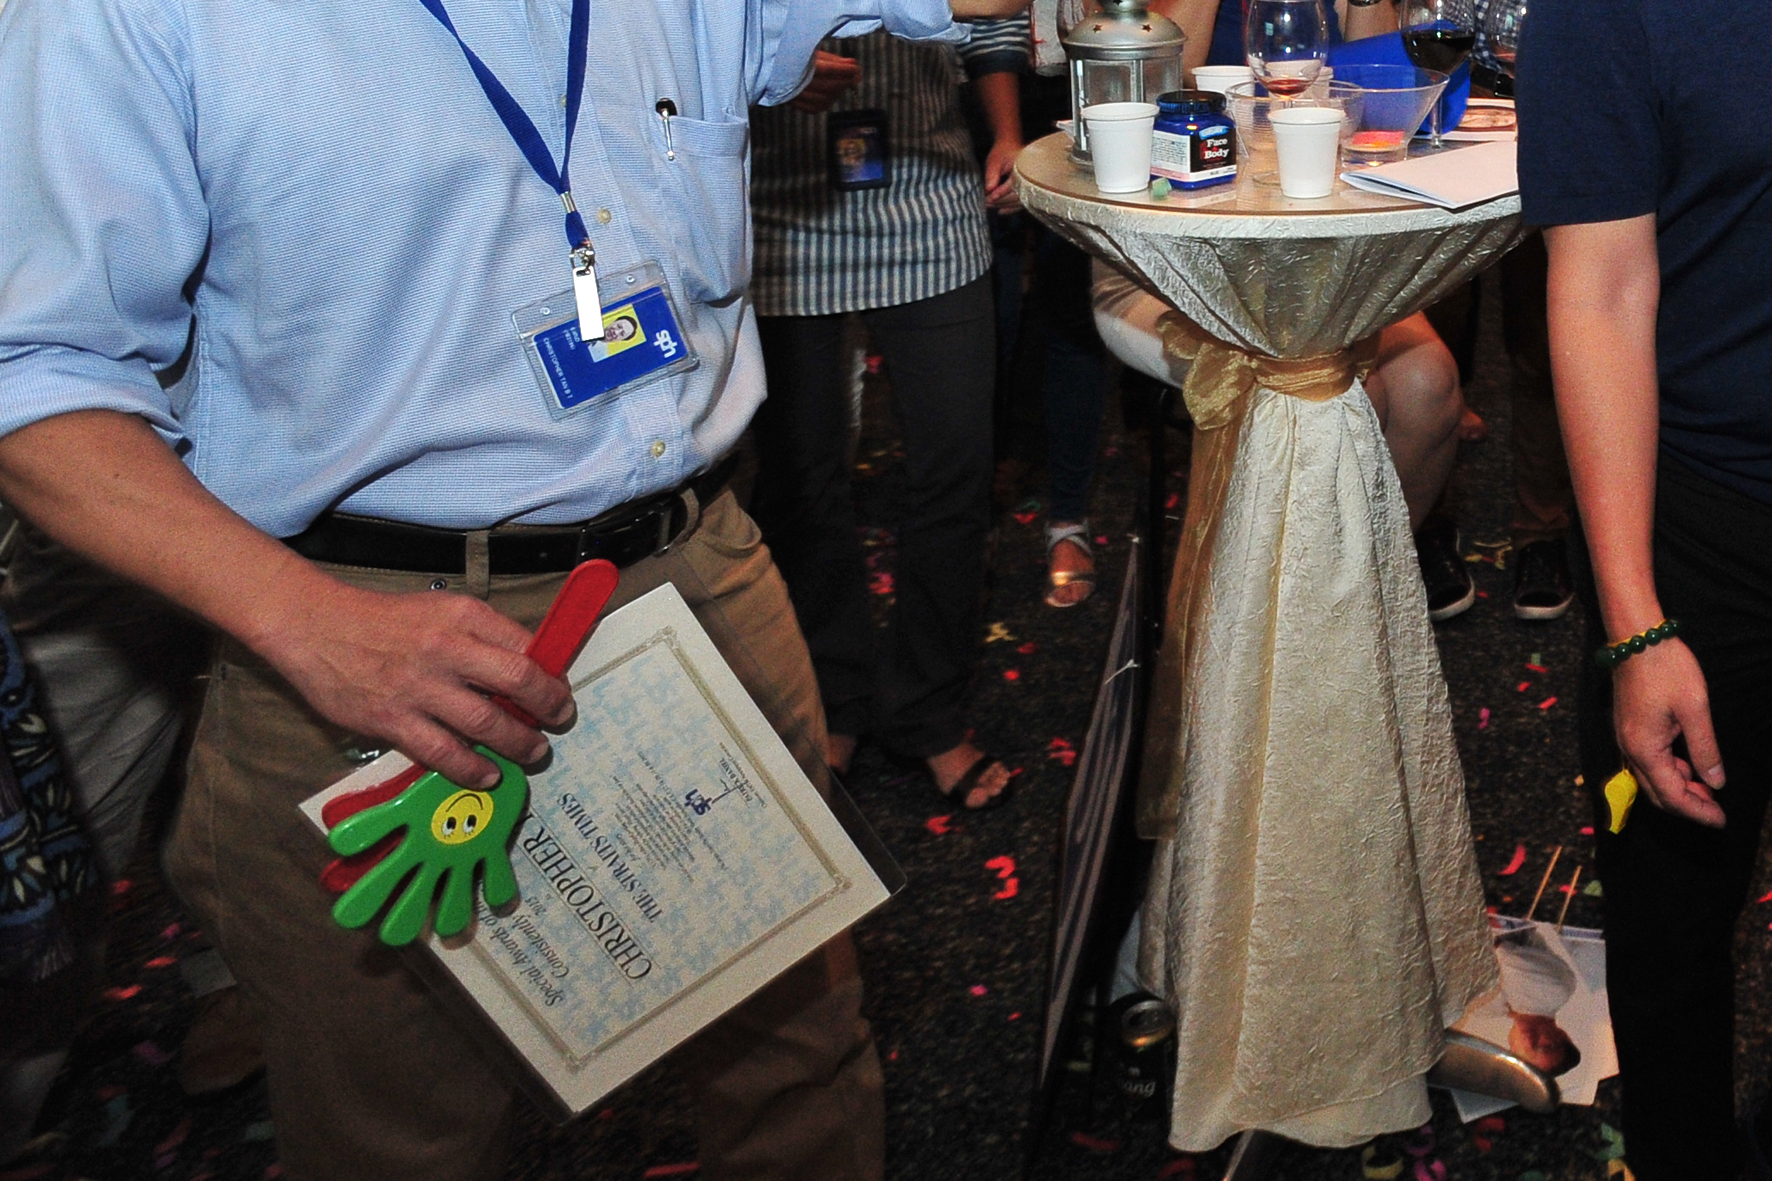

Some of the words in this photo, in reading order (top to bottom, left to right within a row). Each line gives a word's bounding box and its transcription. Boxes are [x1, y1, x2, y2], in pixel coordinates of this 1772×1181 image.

[1205, 148, 1229, 159] Body
[1206, 138, 1228, 147] Face
[653, 329, 677, 358] sph
[555, 790, 599, 840] TIMES
[684, 788, 712, 816] sph
[588, 833, 642, 893] STRAITS
[521, 825, 652, 977] CHRISTOPHER
[524, 894, 547, 916] 2015
[631, 888, 664, 922] THE
[488, 925, 532, 963] Awards
[509, 910, 570, 977] Consistently
[518, 963, 563, 1006] Special
